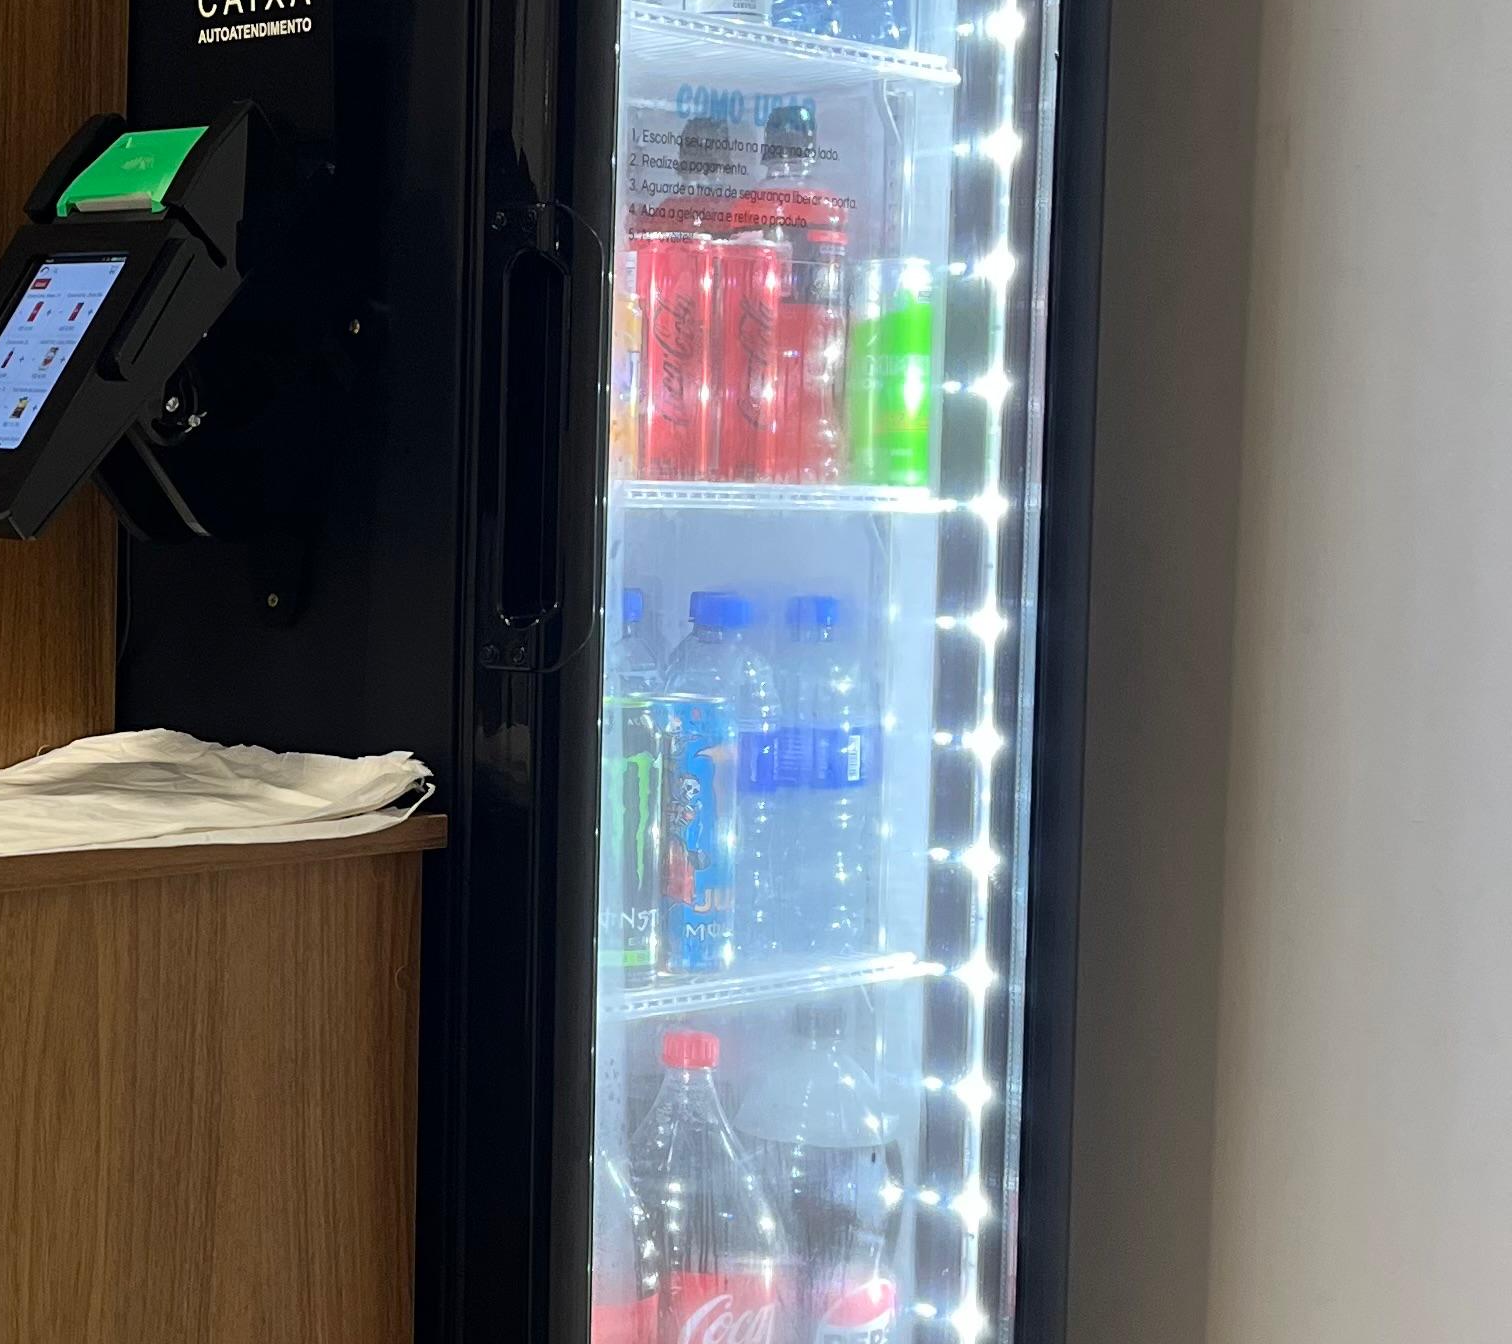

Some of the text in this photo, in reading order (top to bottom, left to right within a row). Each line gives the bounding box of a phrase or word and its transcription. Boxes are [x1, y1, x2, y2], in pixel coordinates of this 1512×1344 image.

[198, 17, 312, 44] AUTOATENDIMENTO
[676, 84, 745, 125] COMO
[643, 129, 684, 146] Escolha
[704, 137, 744, 152] produto
[642, 154, 679, 170] Realize
[641, 179, 686, 197] Aguarde
[697, 184, 723, 197] trava
[725, 185, 737, 199] de
[739, 190, 791, 206] segurança
[641, 204, 666, 219] Abra
